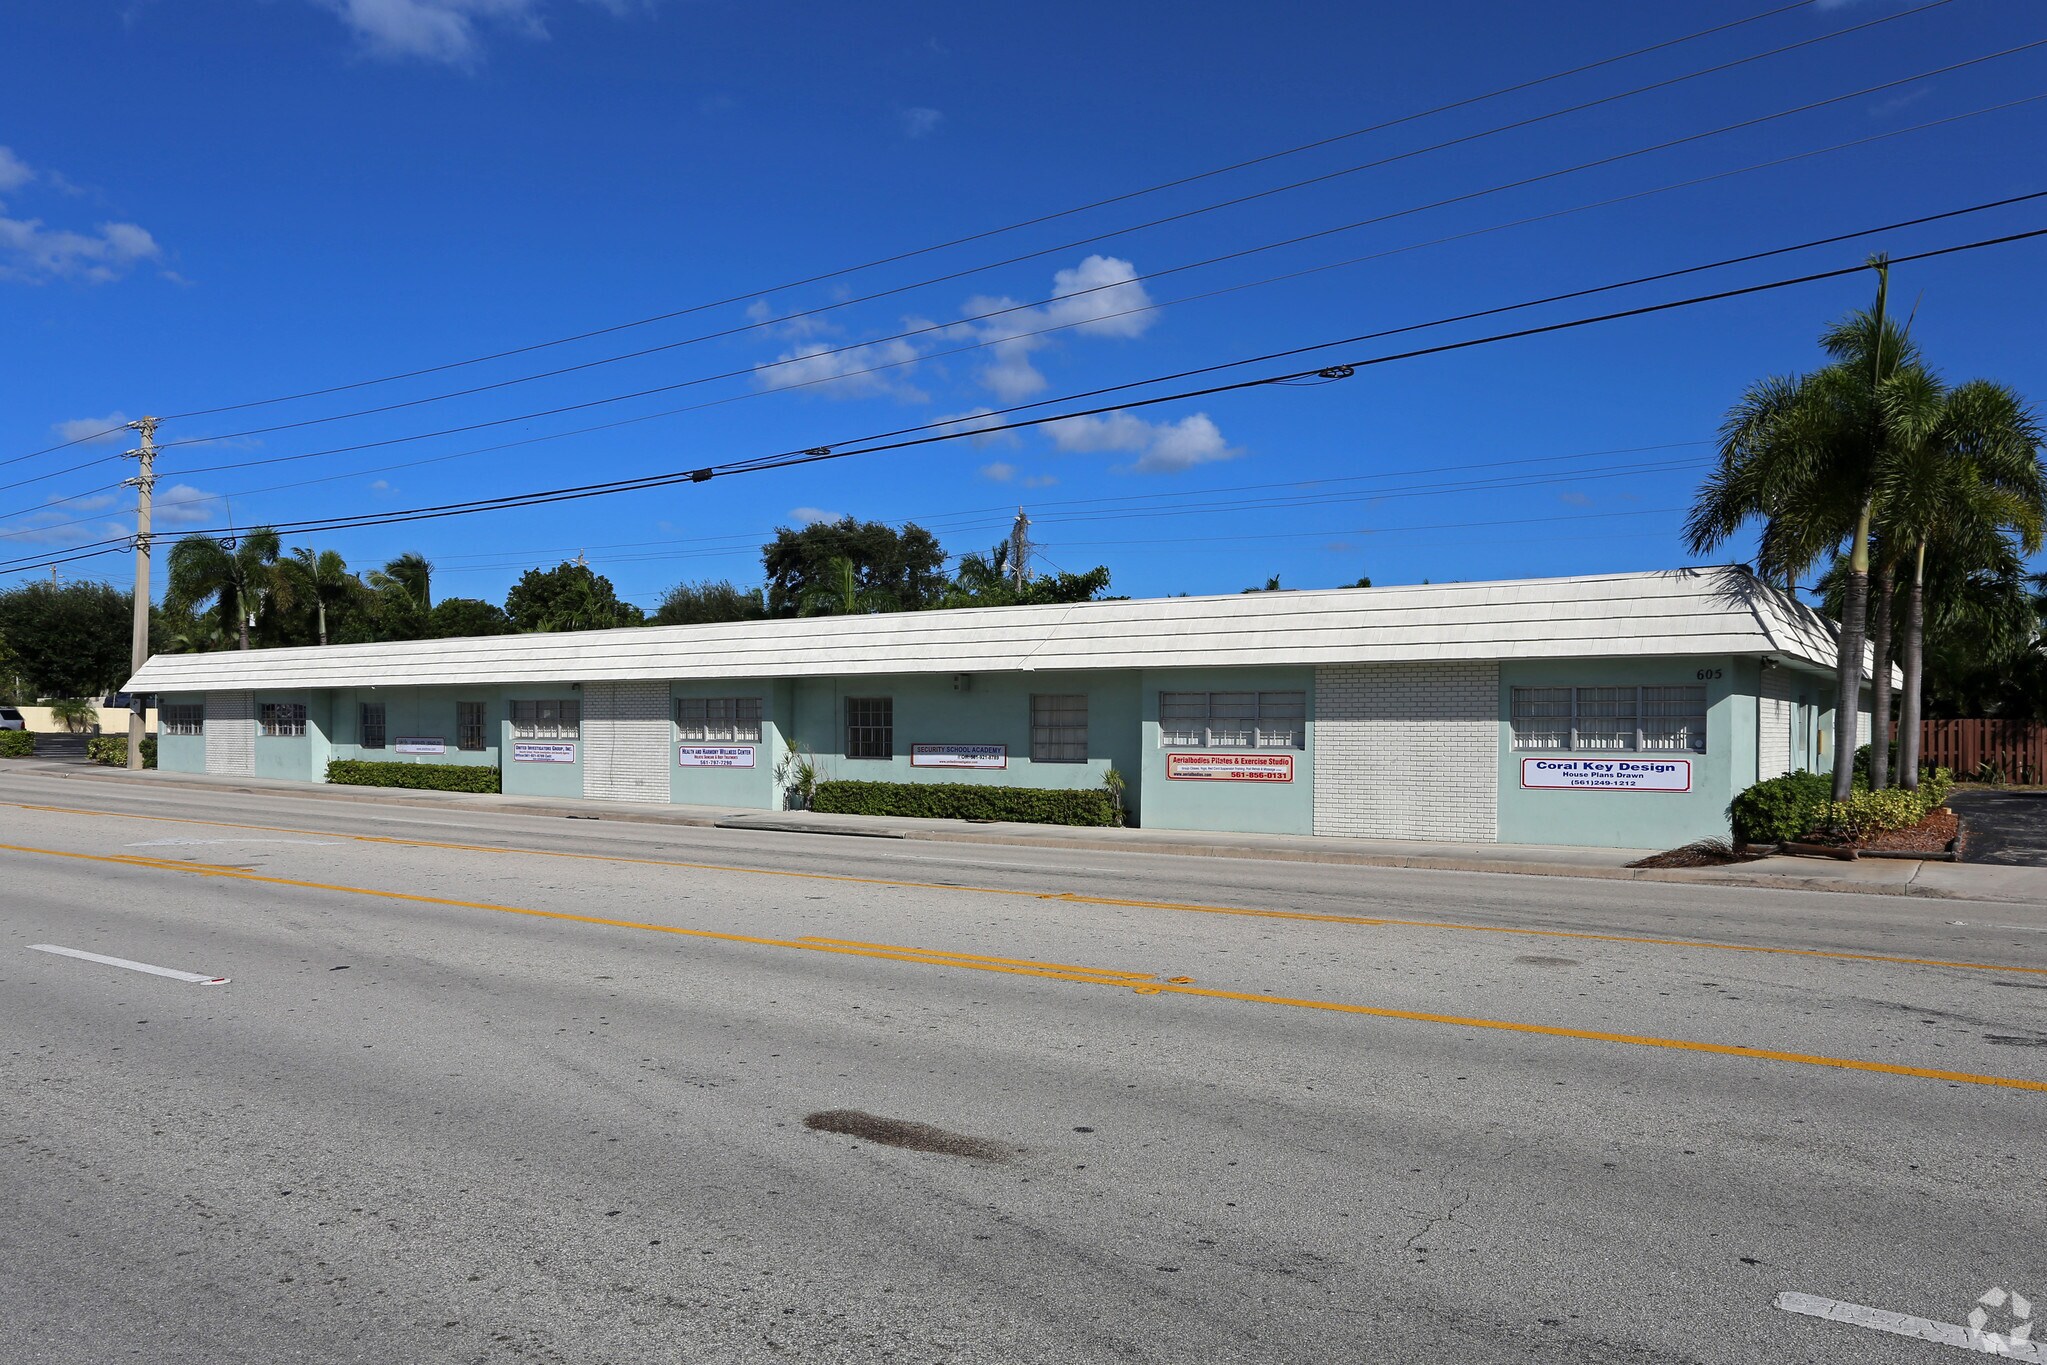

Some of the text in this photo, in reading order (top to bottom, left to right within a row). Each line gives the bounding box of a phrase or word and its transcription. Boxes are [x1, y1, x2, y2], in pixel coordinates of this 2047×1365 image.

[1696, 668, 1722, 680] 605
[1536, 762, 1676, 772] Coral Key Design
